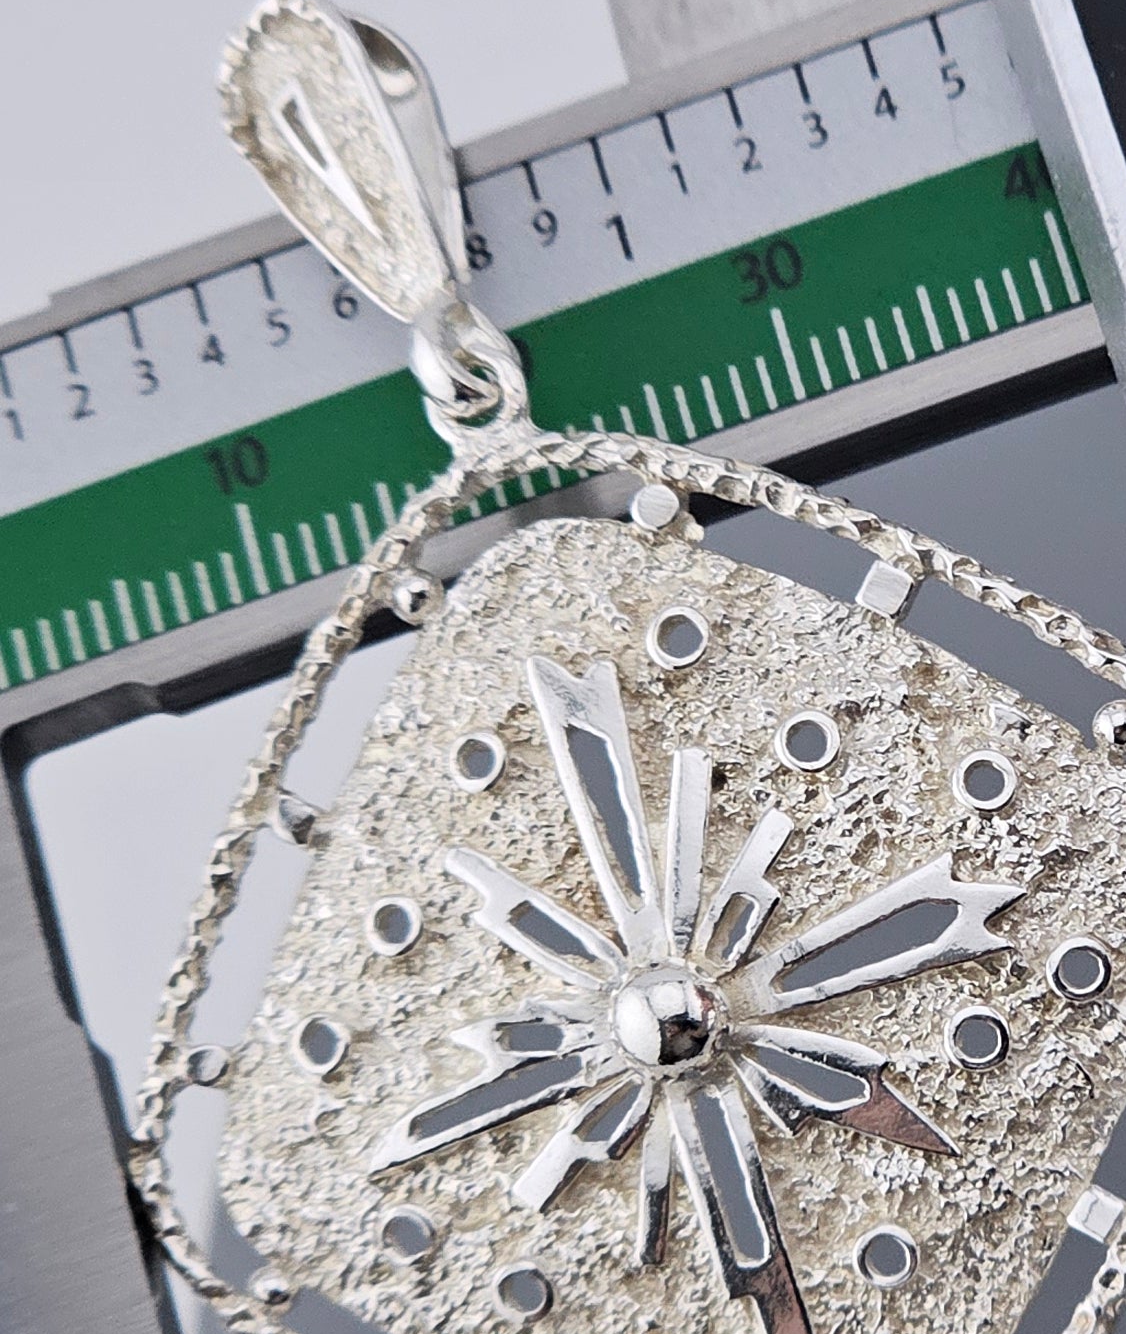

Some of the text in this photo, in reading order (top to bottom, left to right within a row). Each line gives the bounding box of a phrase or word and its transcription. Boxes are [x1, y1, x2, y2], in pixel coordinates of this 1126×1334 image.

[67, 383, 96, 421] 2
[133, 358, 160, 397] 3
[199, 335, 225, 366] 4
[266, 310, 292, 348] 5
[334, 288, 360, 320] 6
[465, 232, 494, 271] 8
[532, 207, 559, 248] 9
[606, 215, 635, 262] 1
[732, 137, 764, 174] 2
[801, 112, 830, 149] 3
[874, 87, 899, 122] 4
[940, 62, 967, 101] 5
[204, 435, 270, 497] 10
[729, 239, 803, 308] 30
